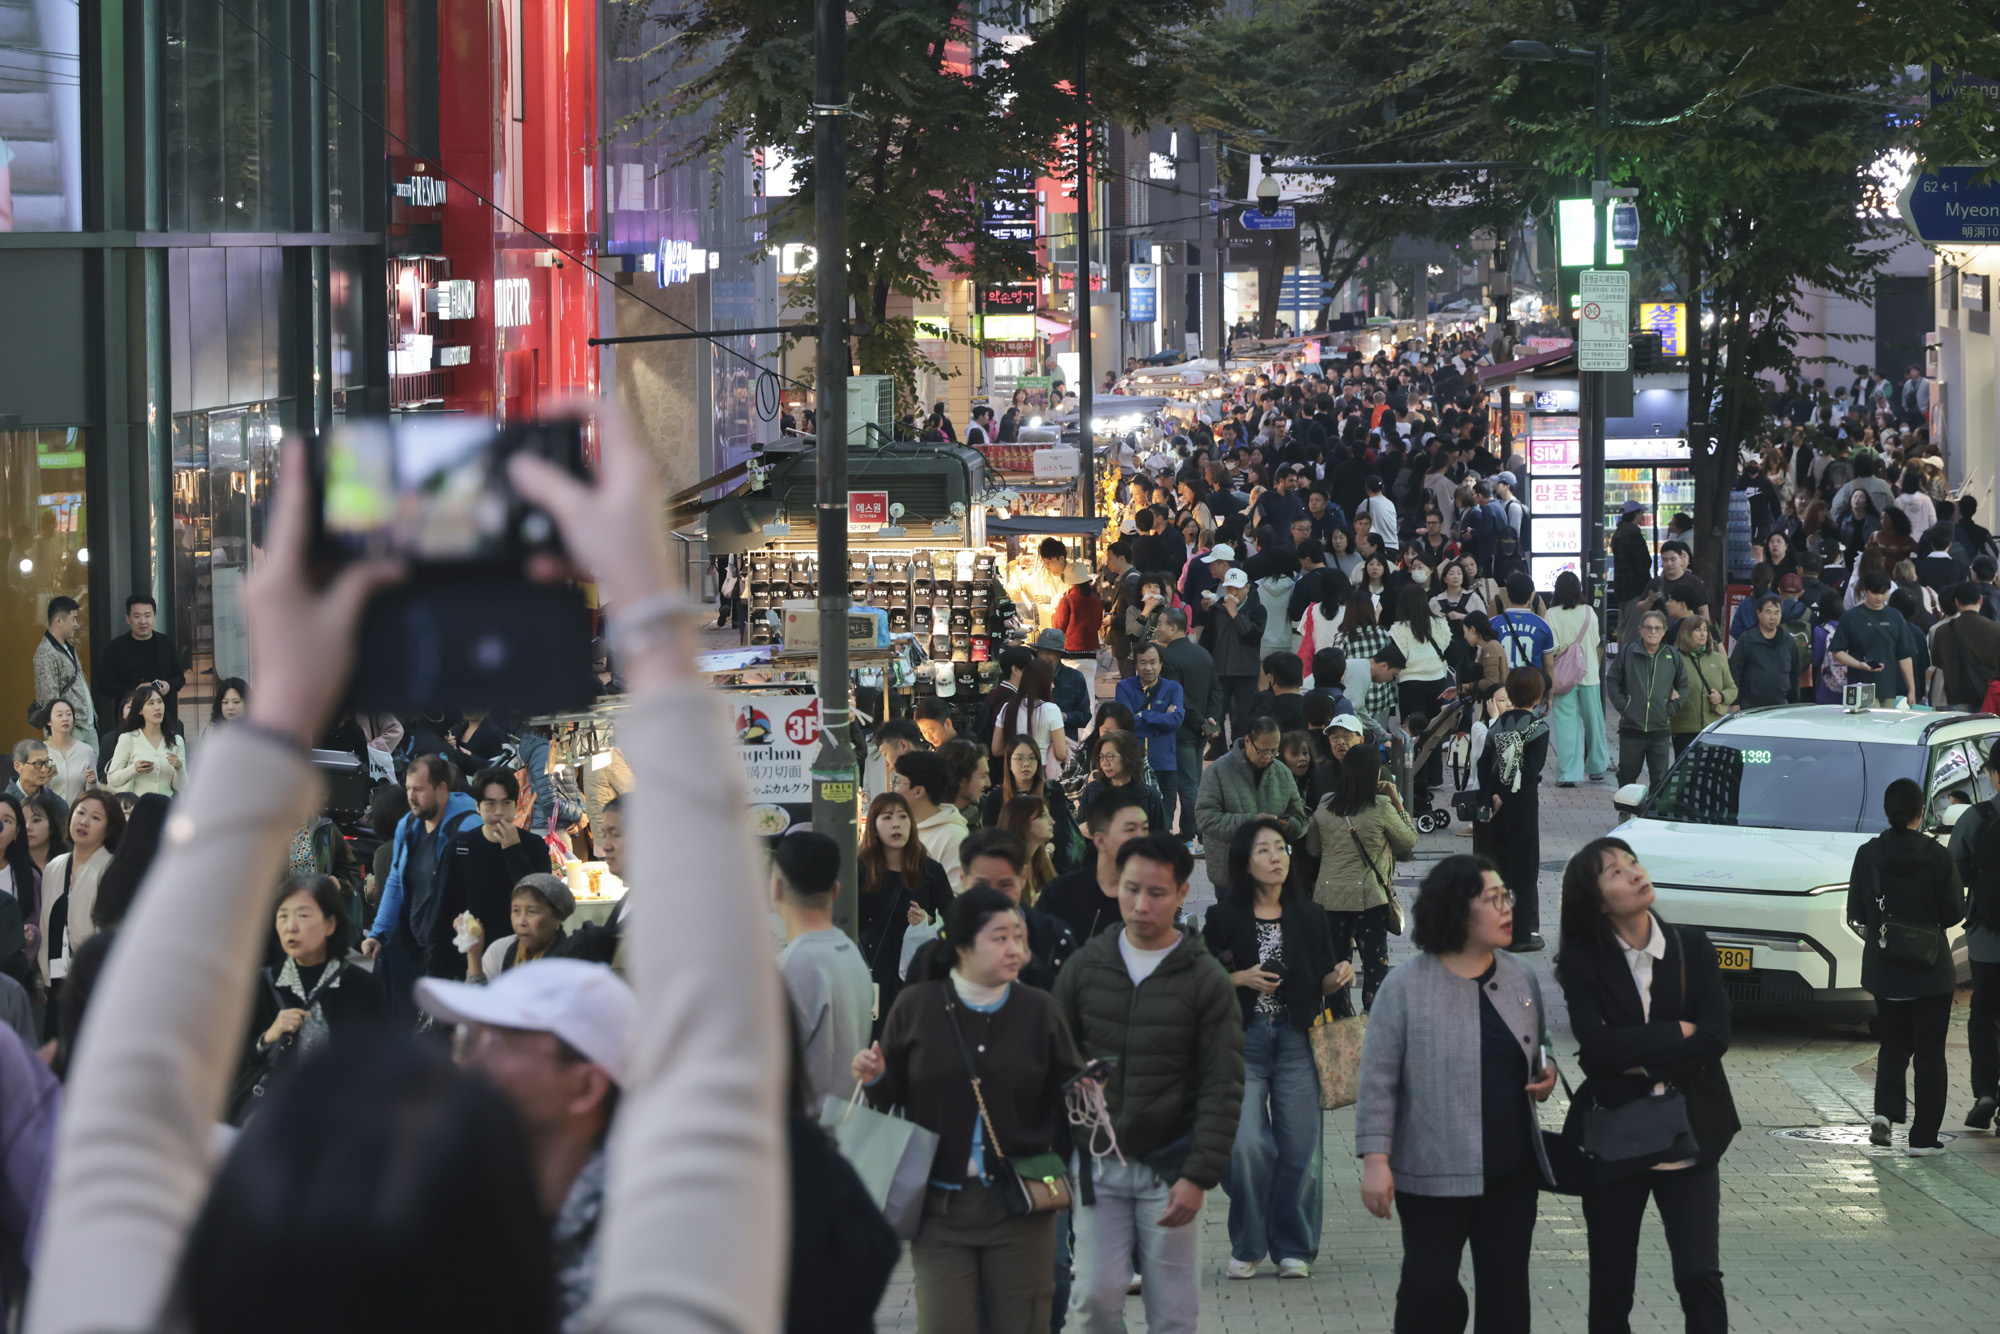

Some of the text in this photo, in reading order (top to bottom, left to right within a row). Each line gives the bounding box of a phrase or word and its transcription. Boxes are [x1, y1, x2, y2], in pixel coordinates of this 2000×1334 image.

[1923, 181, 1938, 193] 62
[1945, 202, 1999, 220] Myeon
[1528, 340, 1555, 348] Lamb
[1537, 396, 1558, 406] 43-2
[1533, 446, 1565, 462] SIM
[855, 502, 881, 514] 에스원
[1500, 623, 1537, 635] ZIDANE
[1501, 635, 1534, 669] 10
[1741, 750, 1772, 764] 1380
